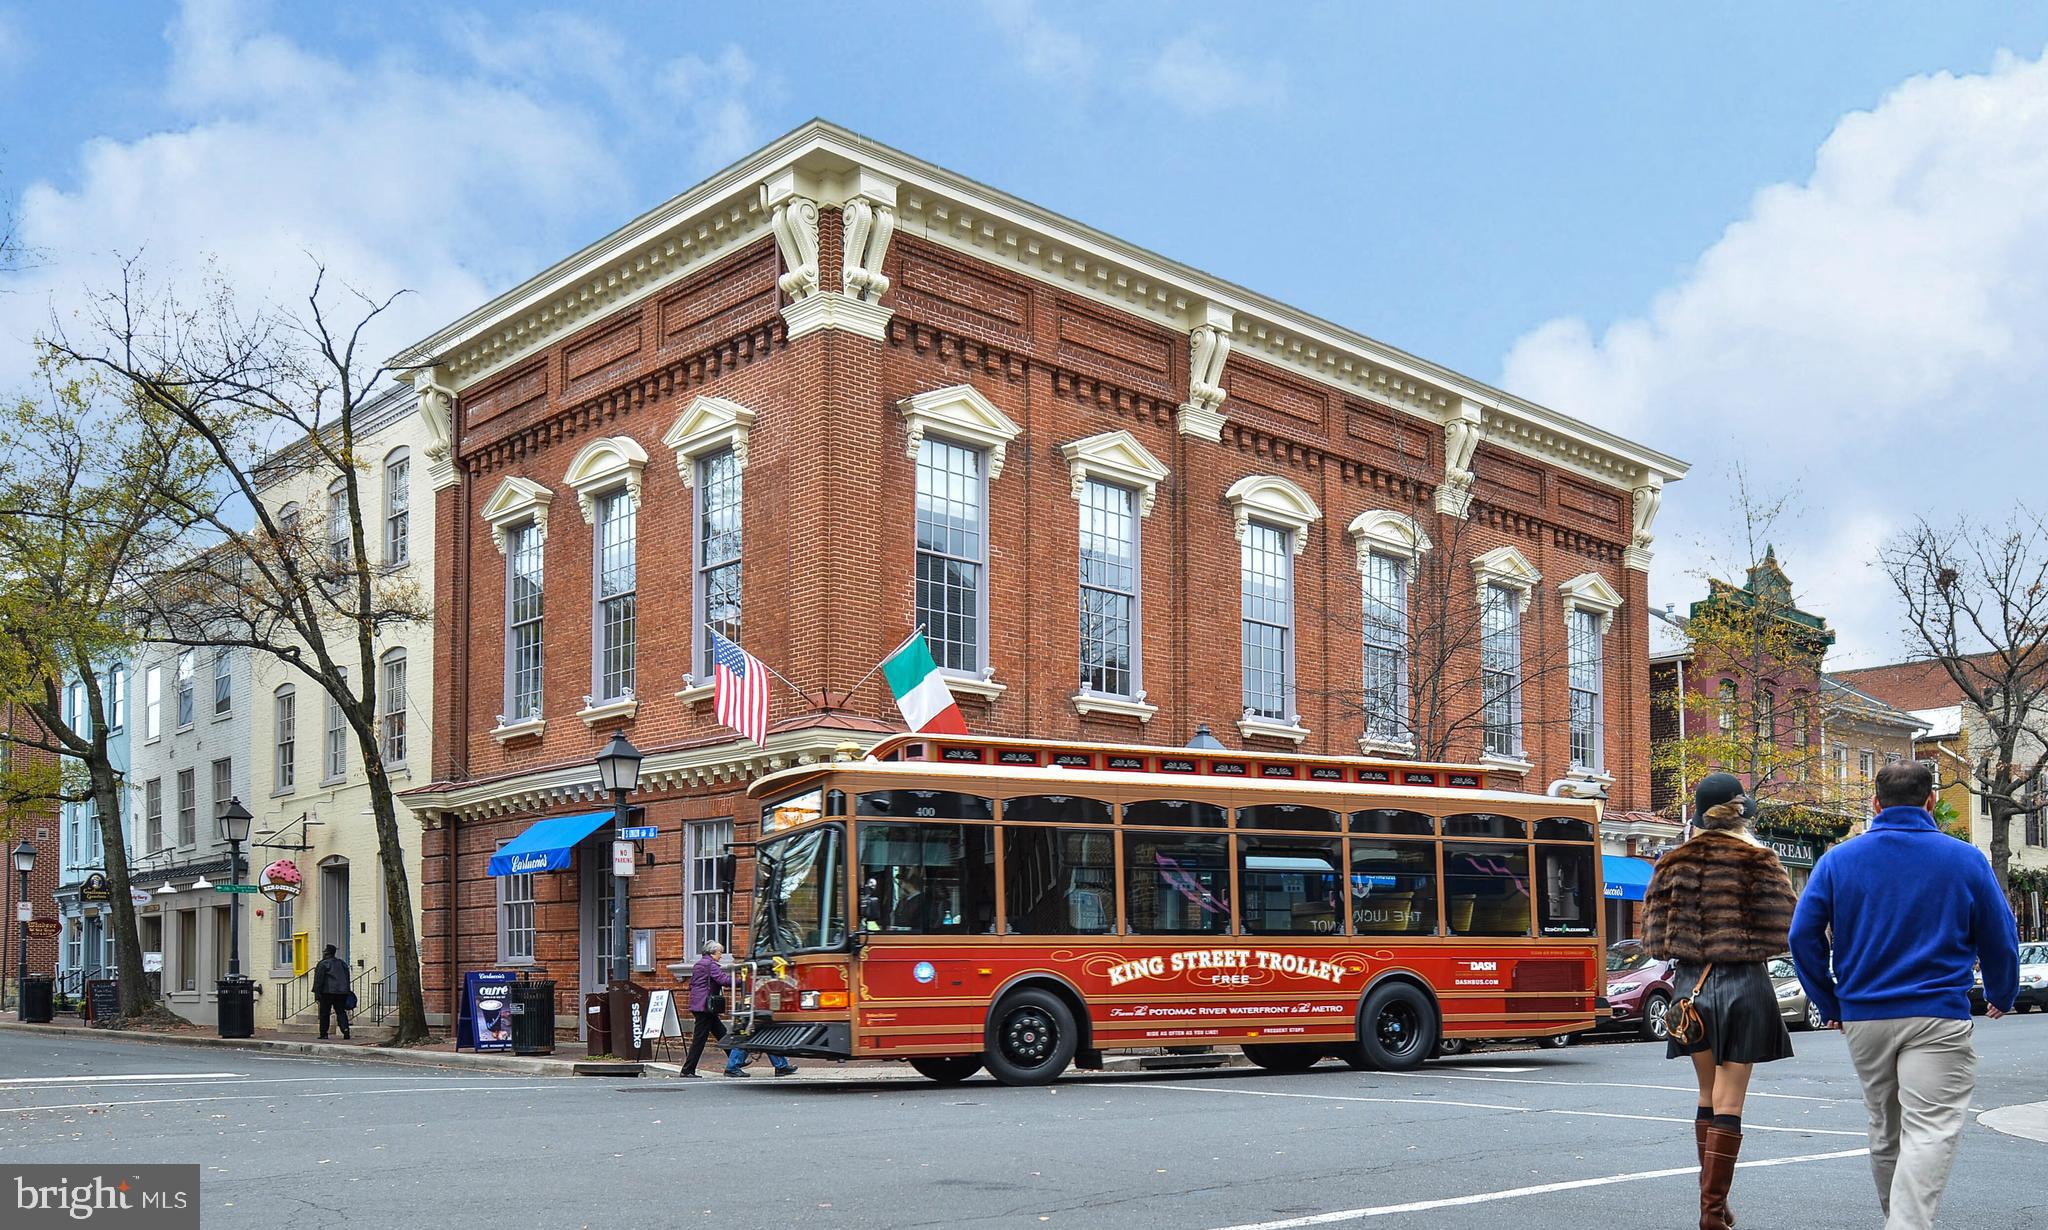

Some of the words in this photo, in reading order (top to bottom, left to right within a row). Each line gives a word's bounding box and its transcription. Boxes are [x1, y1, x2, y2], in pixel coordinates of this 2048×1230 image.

[916, 807, 936, 817] 400
[619, 849, 628, 857] NO
[1772, 842, 1812, 860] CREAM
[512, 853, 548, 873] Carluccio's
[1603, 883, 1624, 897] luccio's
[1107, 956, 1166, 987] KING
[1171, 949, 1250, 972] STREET
[1256, 950, 1346, 984] TROLLEY
[1470, 962, 1497, 971] DASH
[1212, 975, 1249, 984] FREE
[1229, 1006, 1290, 1014] WATERFRONT
[1311, 1005, 1343, 1013] METRO
[632, 1002, 642, 1049] express
